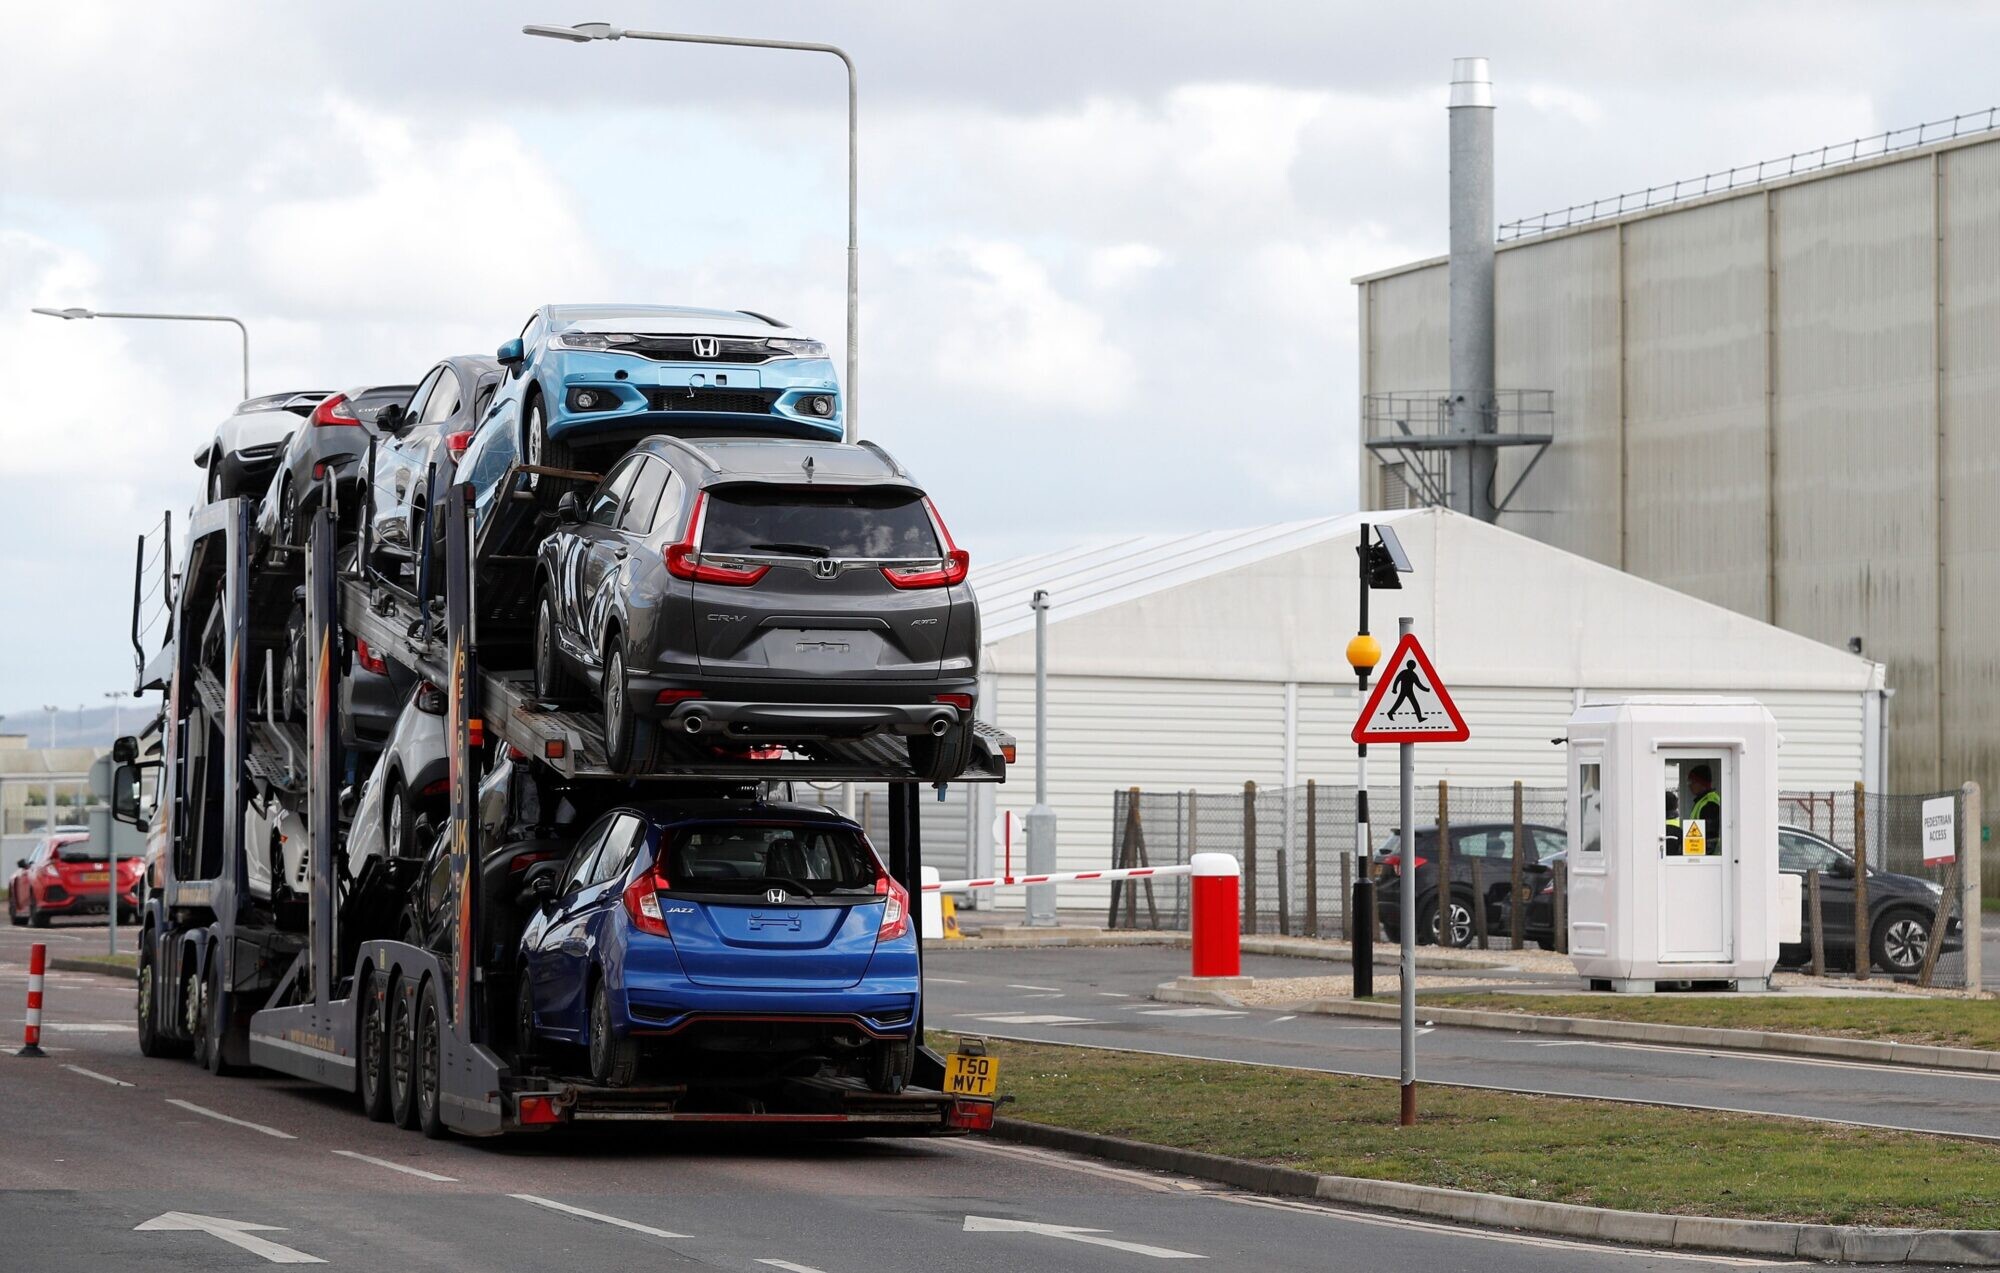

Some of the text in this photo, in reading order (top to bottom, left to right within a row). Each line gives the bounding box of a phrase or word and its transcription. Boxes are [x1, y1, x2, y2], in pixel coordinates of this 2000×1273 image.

[706, 613, 748, 623] CR-V
[910, 618, 938, 626] AWD
[450, 624, 467, 1024] IRELAND UK EUROPE
[1924, 814, 1952, 828] PEDESTRIAN
[1929, 829, 1947, 841] ACCESS
[957, 1057, 989, 1075] T50
[953, 1074, 987, 1093] MVT
